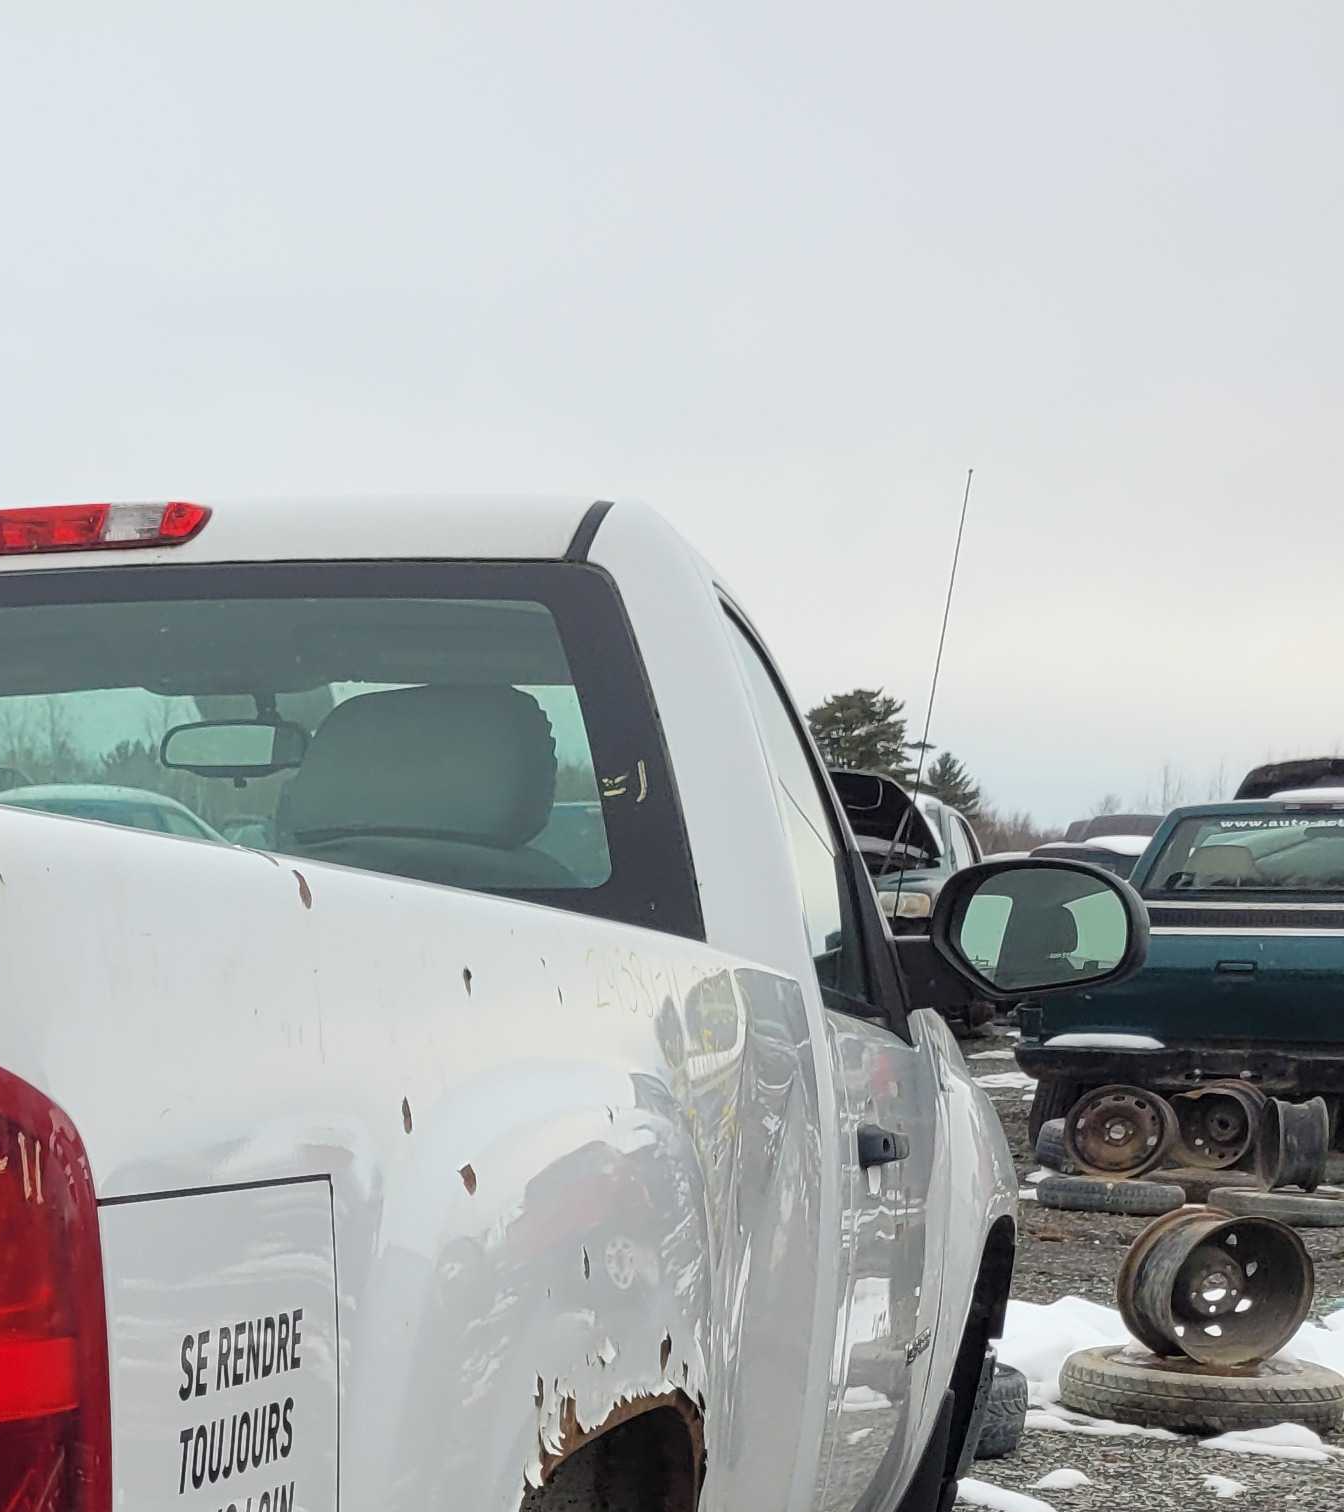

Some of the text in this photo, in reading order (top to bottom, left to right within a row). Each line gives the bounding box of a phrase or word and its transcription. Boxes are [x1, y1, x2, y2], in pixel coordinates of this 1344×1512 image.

[178, 1308, 304, 1401] SE RENDRE
[177, 1396, 295, 1495] TOUJOURS
